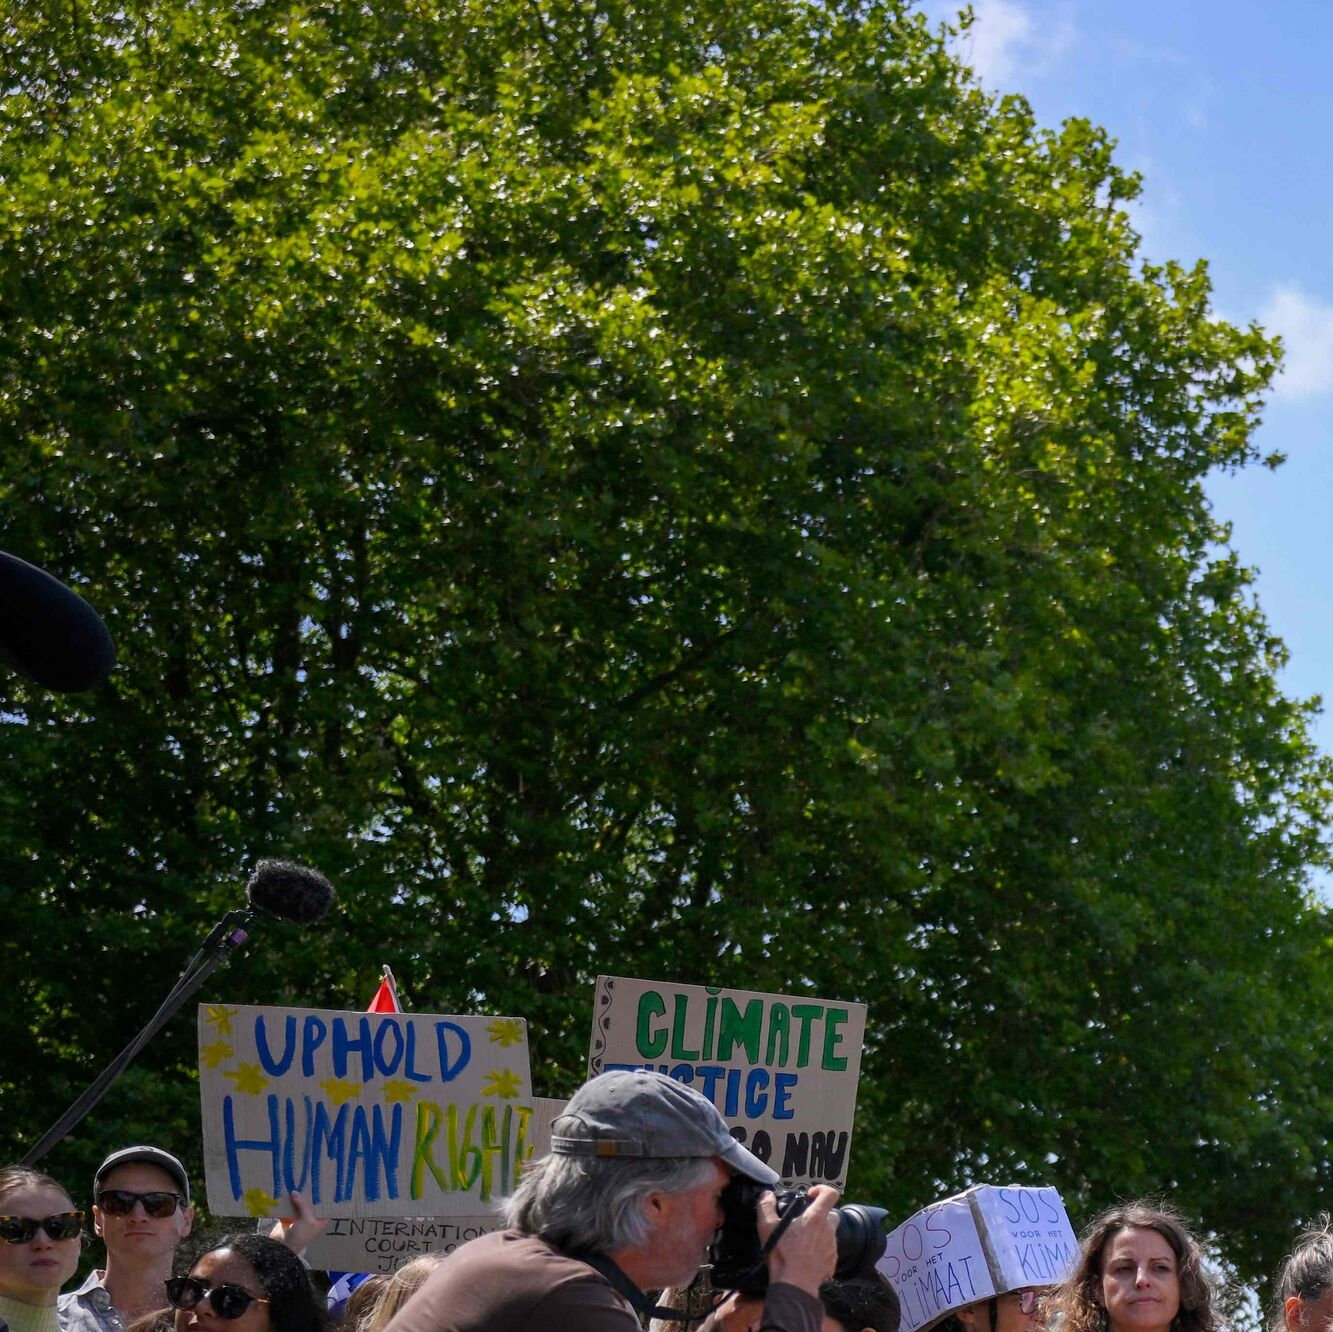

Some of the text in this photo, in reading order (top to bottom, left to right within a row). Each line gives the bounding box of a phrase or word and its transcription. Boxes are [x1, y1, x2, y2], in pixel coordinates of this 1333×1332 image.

[255, 1014, 471, 1083] UPHOLD
[223, 1093, 535, 1205] HUMAN RIGHT
[1000, 1189, 1060, 1224] SOS
[365, 1237, 432, 1253] COURT
[1011, 1230, 1063, 1239] VOOR HET
[926, 1252, 944, 1266] HET
